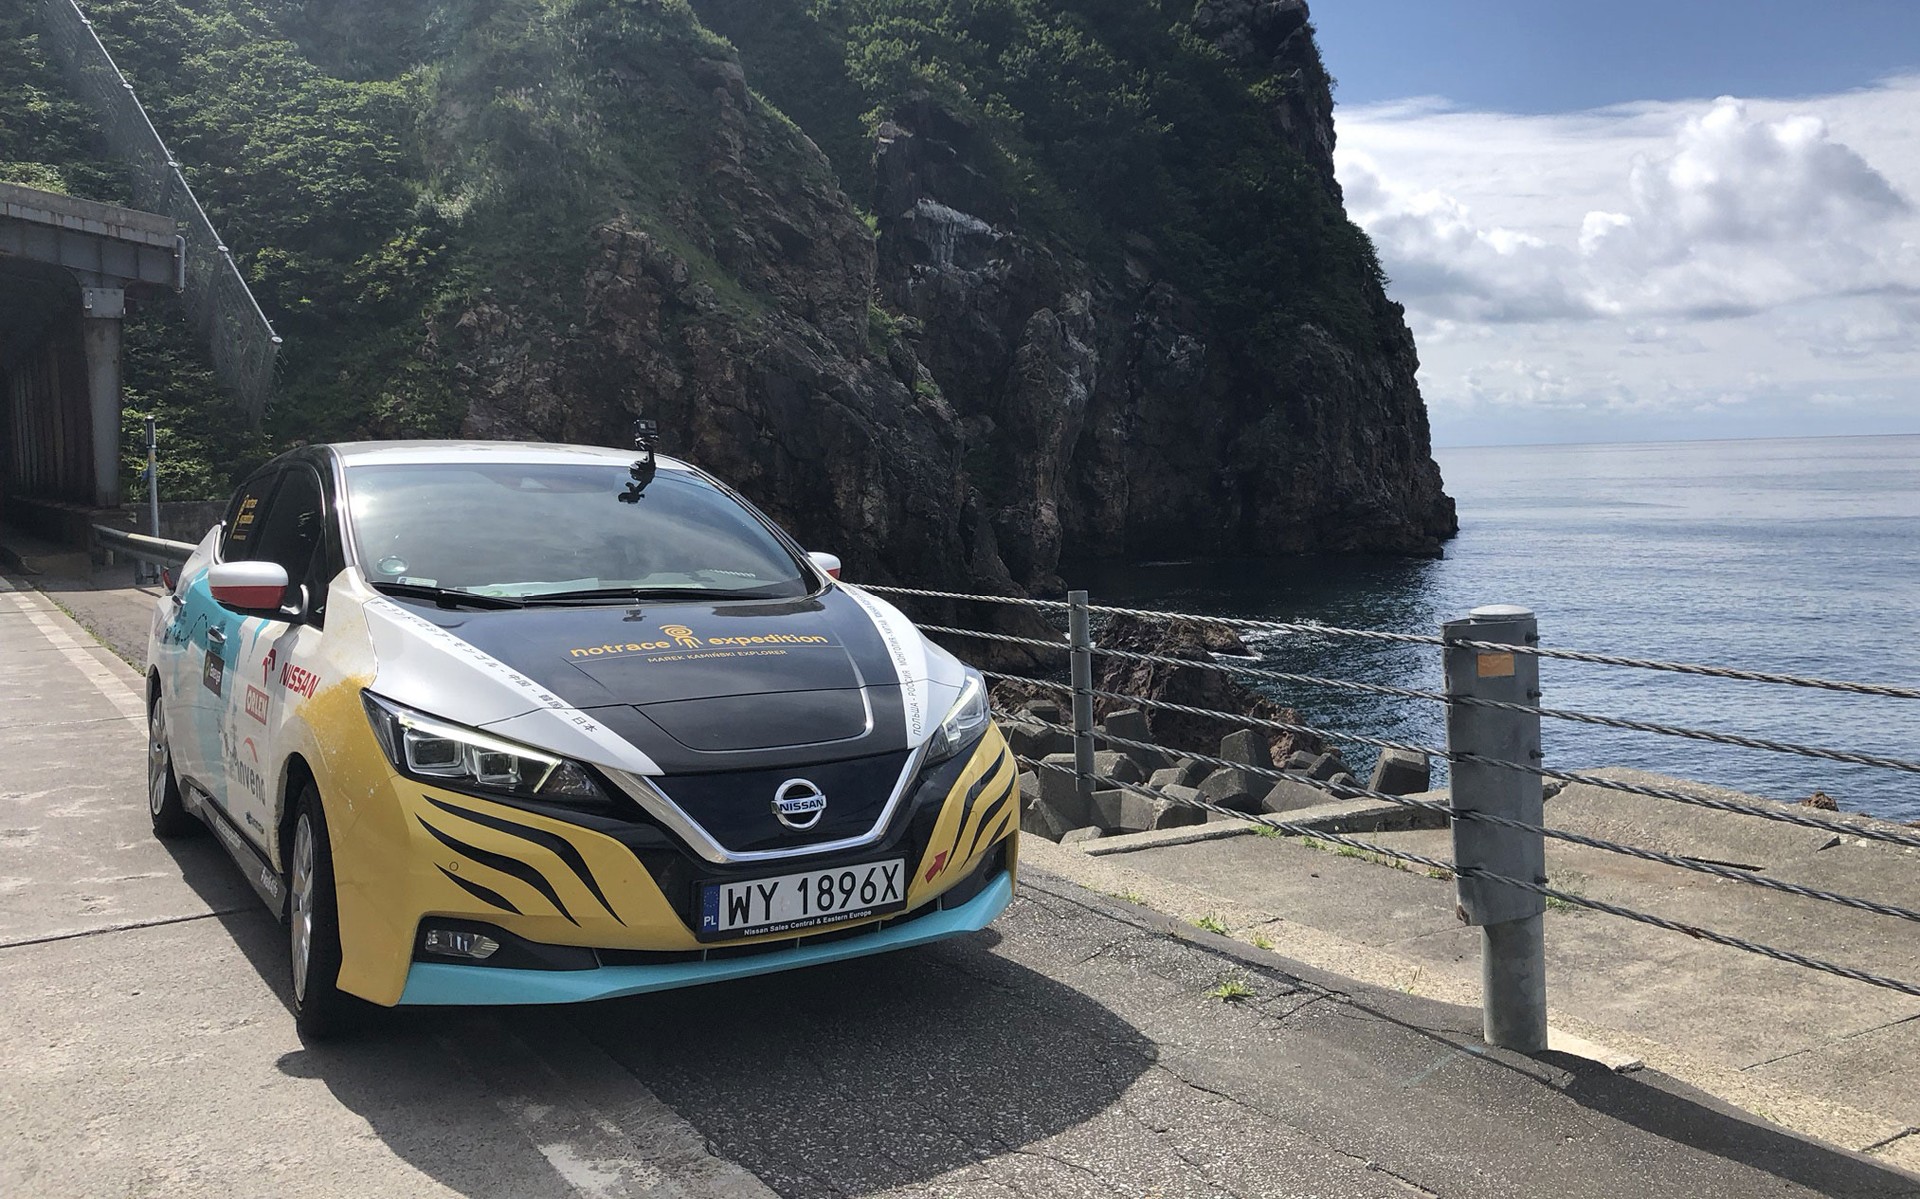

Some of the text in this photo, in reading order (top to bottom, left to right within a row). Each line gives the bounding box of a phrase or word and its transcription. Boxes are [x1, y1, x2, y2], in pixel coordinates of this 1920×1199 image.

[569, 633, 829, 658] notrace expedition
[647, 655, 686, 663] MAREK
[737, 649, 788, 657] EXPLORER
[279, 661, 321, 700] NISSAN
[246, 689, 268, 718] ORLEN
[508, 674, 532, 687] 中国
[571, 716, 598, 733] 日本
[910, 702, 922, 737] ПОЛЬША
[779, 799, 825, 812] NISSAN
[727, 863, 900, 927] WY 1896X
[703, 915, 717, 927] PL
[743, 928, 769, 936] Nissan
[769, 924, 789, 932] Sales
[790, 919, 815, 929] Central
[822, 914, 849, 924] Eastern
[849, 909, 873, 919] Europe
